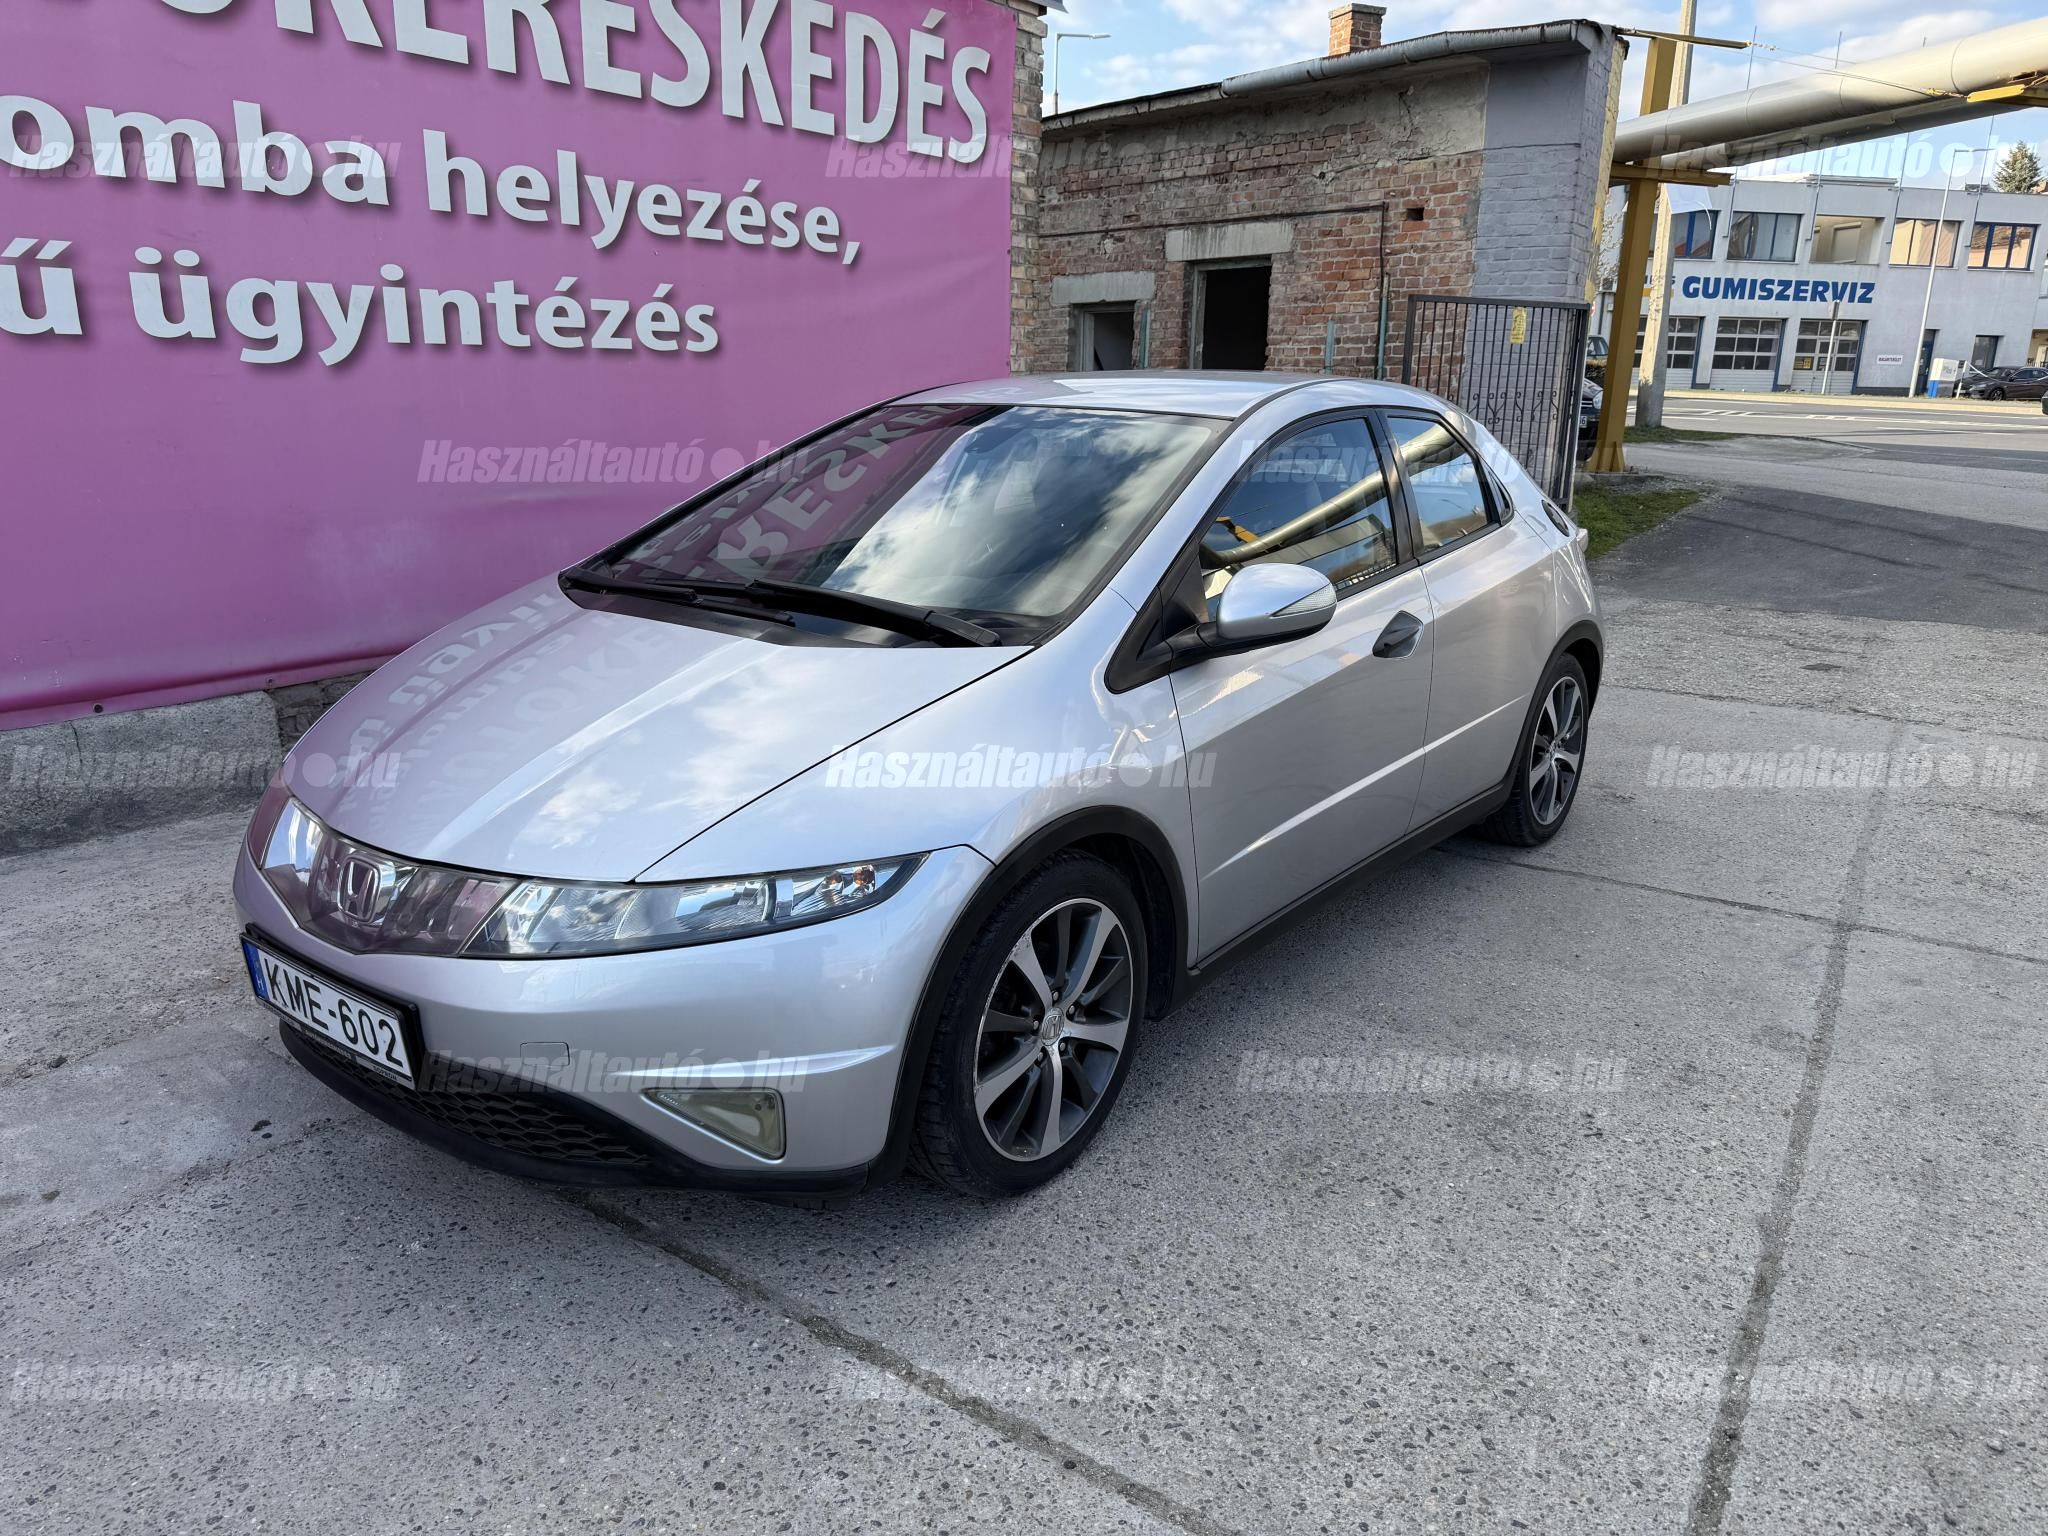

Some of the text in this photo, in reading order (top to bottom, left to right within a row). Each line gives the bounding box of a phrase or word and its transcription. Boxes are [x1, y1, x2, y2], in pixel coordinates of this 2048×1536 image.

[423, 129, 861, 265] helyezése,
[128, 246, 719, 366] ügyintézés
[1682, 275, 1875, 303] GUMISZERVIZ
[264, 958, 404, 1068] KME-602
